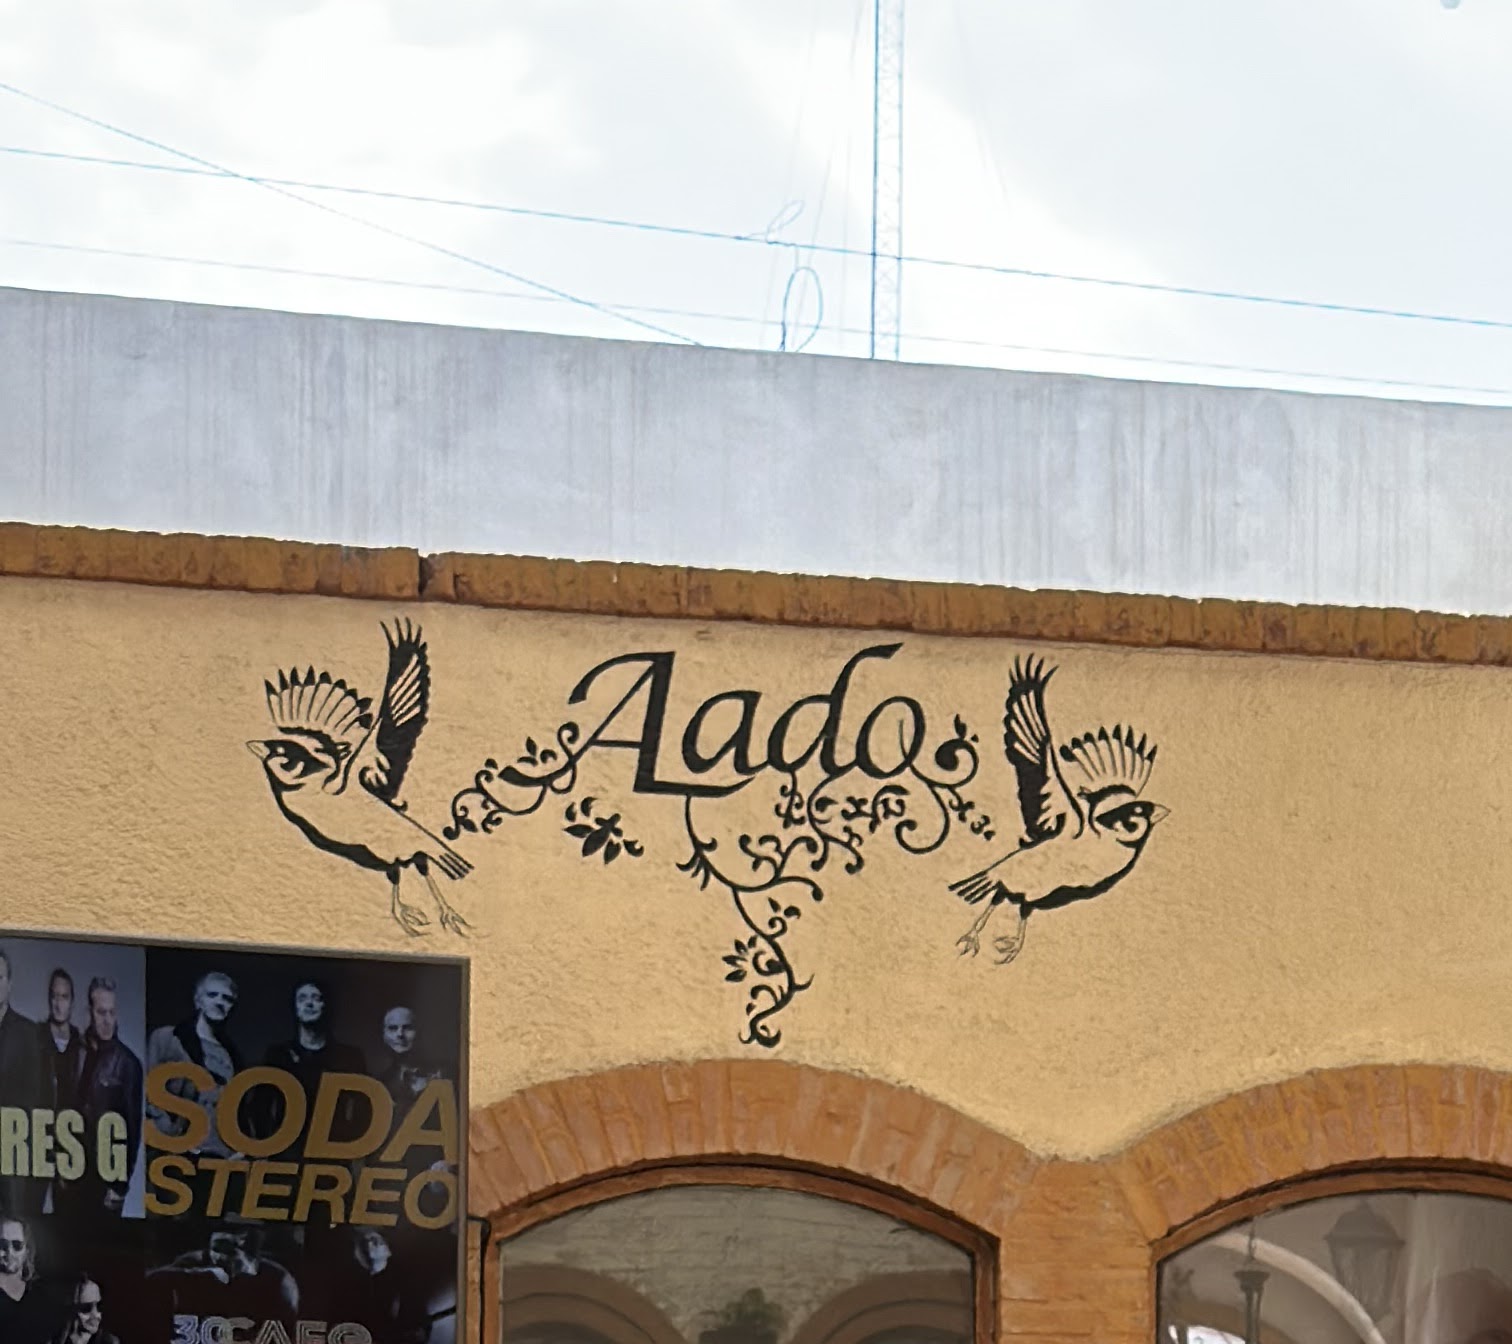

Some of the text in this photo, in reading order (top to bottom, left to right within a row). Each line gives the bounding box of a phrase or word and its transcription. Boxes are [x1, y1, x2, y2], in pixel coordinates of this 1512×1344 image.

[0, 1107, 128, 1182] RES G
[144, 1061, 459, 1167] SODA
[145, 1154, 459, 1231] STEREO
